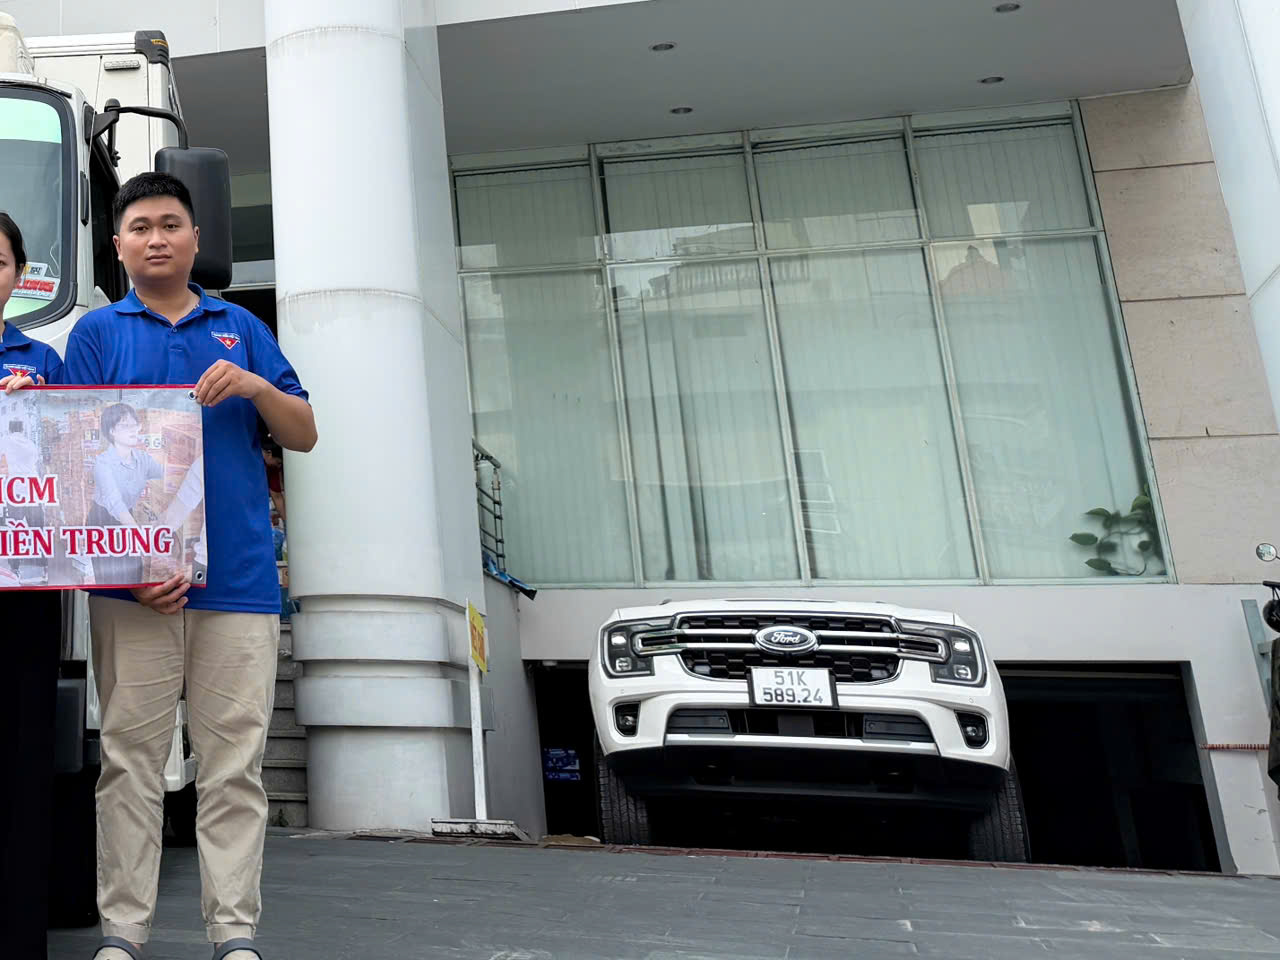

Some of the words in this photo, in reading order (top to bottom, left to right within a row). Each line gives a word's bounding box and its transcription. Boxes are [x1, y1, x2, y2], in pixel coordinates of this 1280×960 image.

[63, 526, 173, 555] TRUNG
[771, 631, 801, 644] Ford
[773, 670, 808, 686] 51K
[762, 687, 824, 704] 589.24
